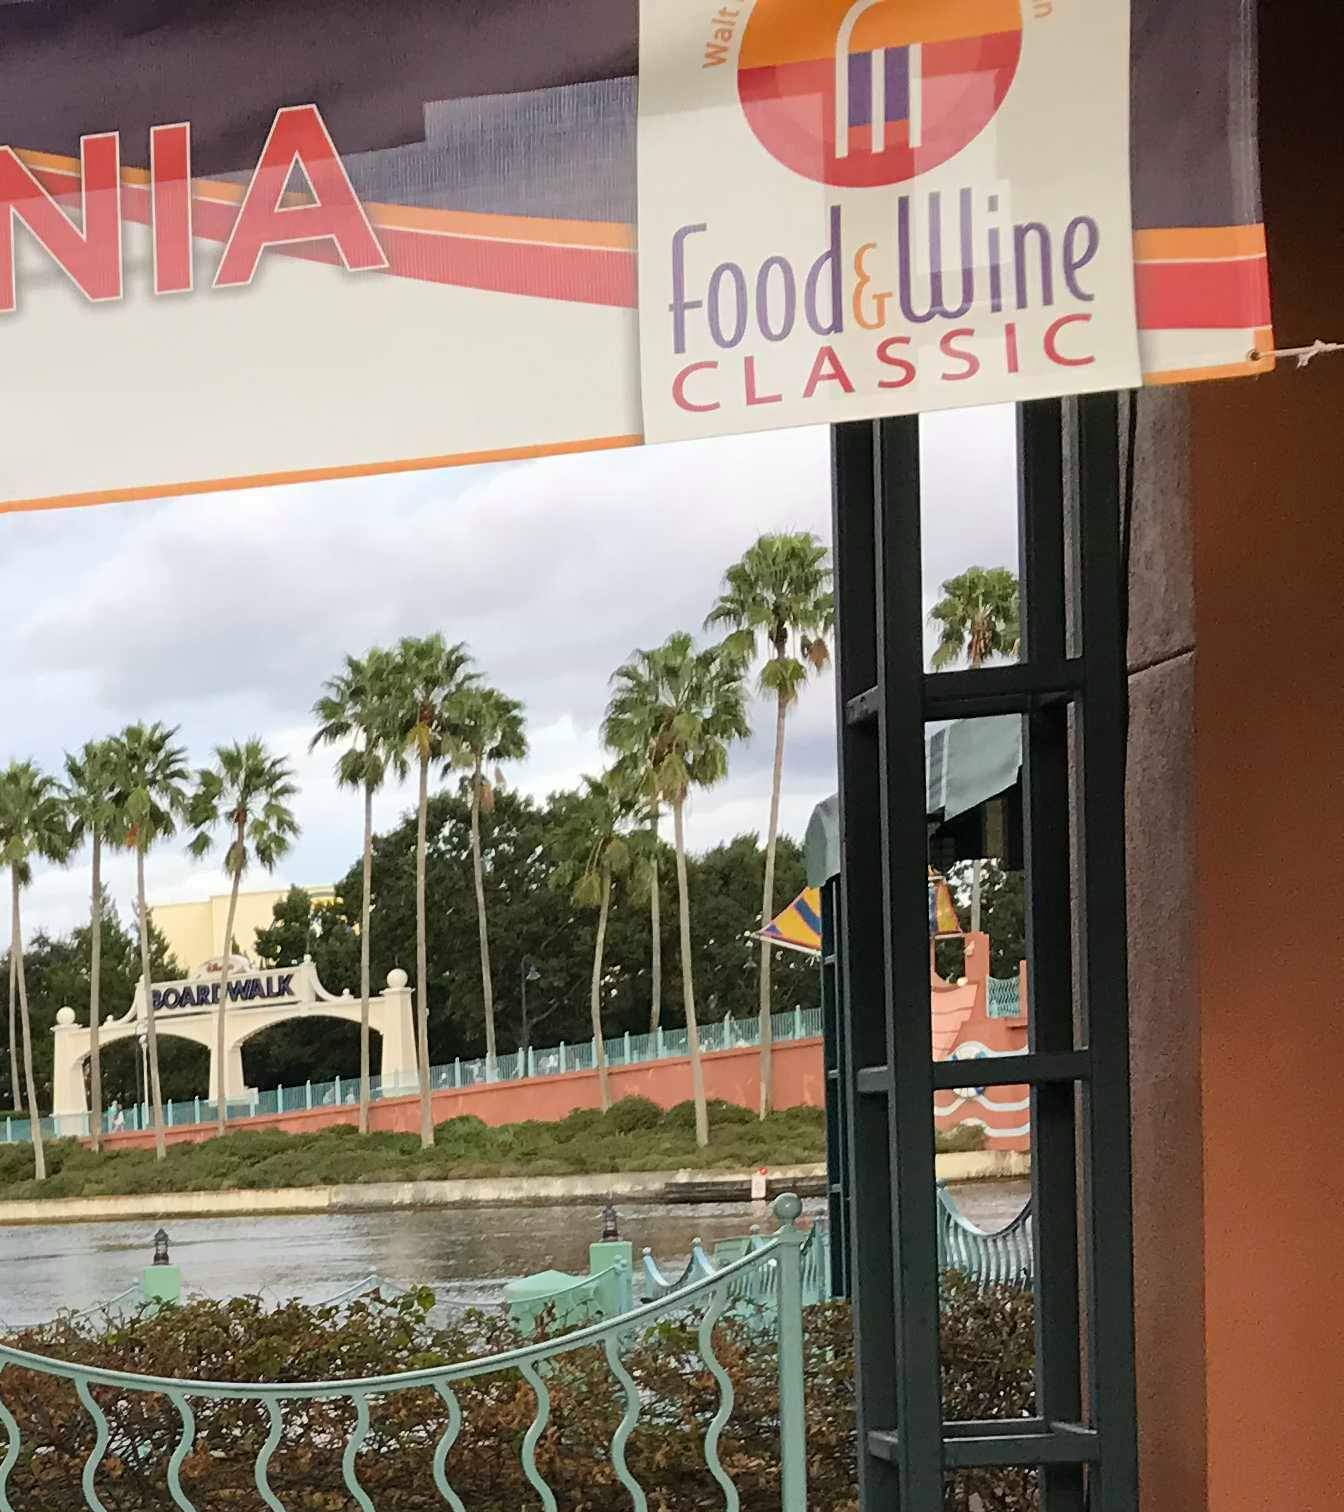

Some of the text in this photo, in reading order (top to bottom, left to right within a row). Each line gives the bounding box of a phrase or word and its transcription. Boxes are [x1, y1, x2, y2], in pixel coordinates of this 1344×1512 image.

[702, 7, 739, 69] Walt
[672, 312, 1096, 413] CLASSIC
[152, 973, 295, 1011] BOARDWALK
